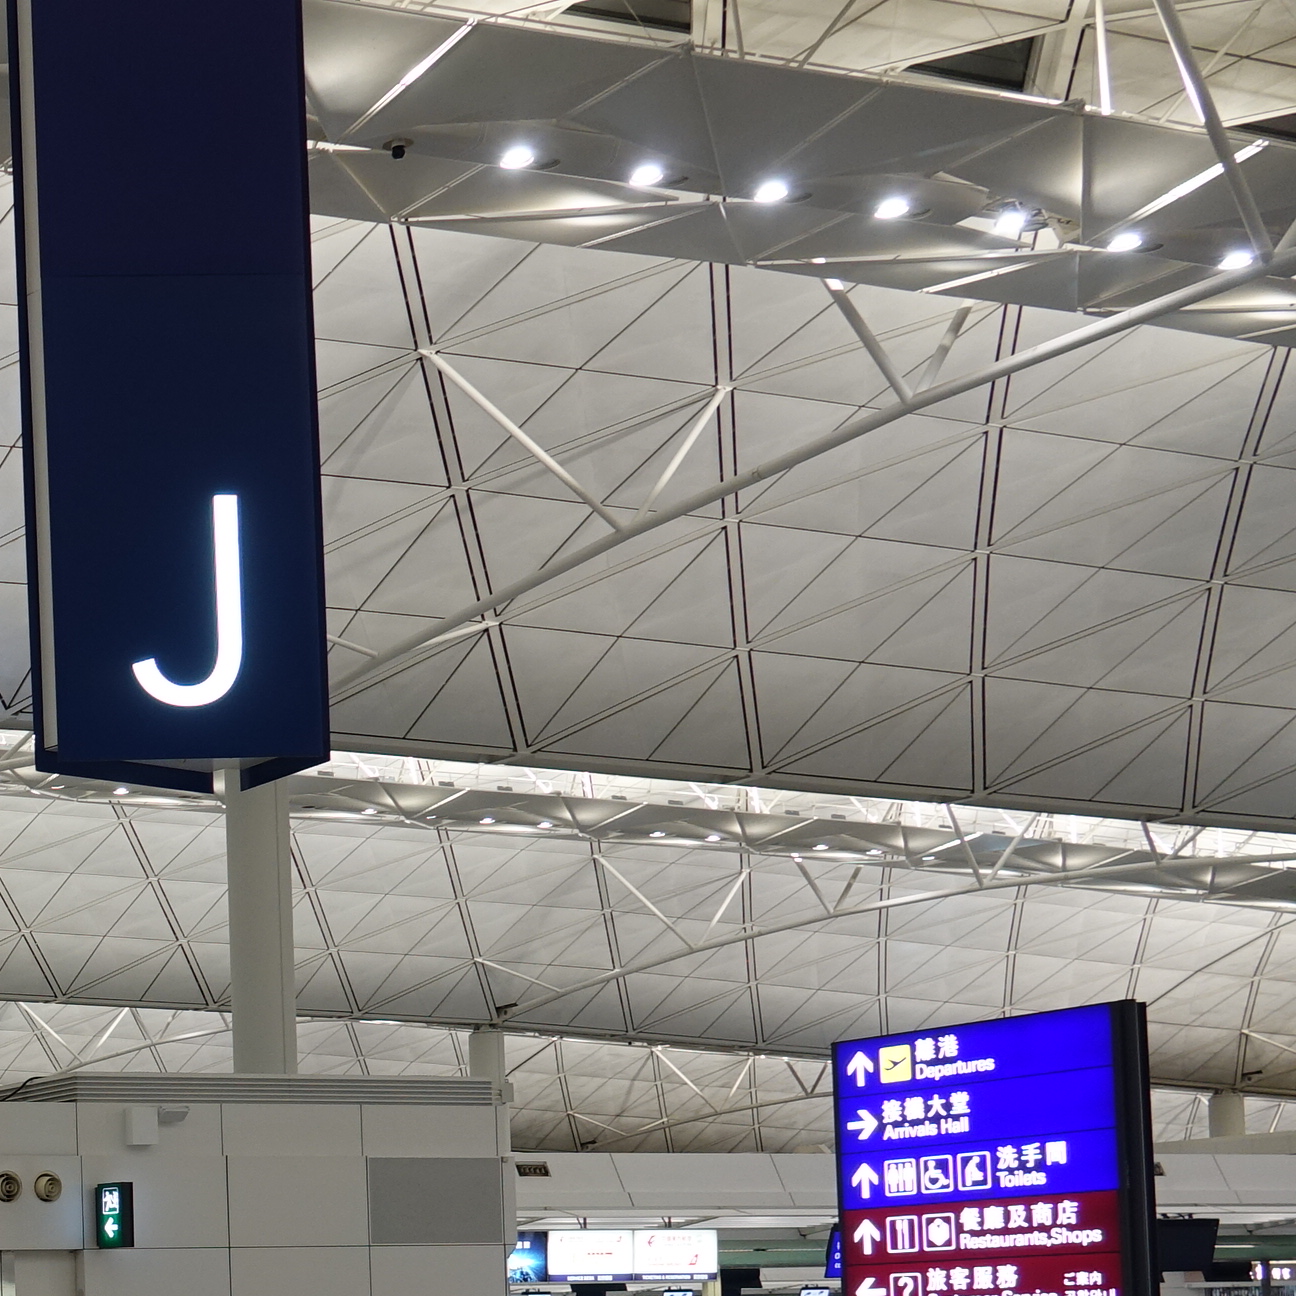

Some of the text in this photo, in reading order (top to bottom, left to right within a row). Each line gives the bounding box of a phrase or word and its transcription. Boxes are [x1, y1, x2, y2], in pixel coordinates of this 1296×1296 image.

[131, 493, 243, 708] J
[914, 1057, 995, 1081] Departures
[881, 1091, 971, 1124] 接機大堂
[882, 1116, 970, 1141] Arrivals Hall
[995, 1140, 1067, 1170] 洗手間
[995, 1169, 1047, 1188] Toilets
[959, 1227, 1103, 1250] Restaurants,Shops
[926, 1264, 1018, 1291] 旅客服務
